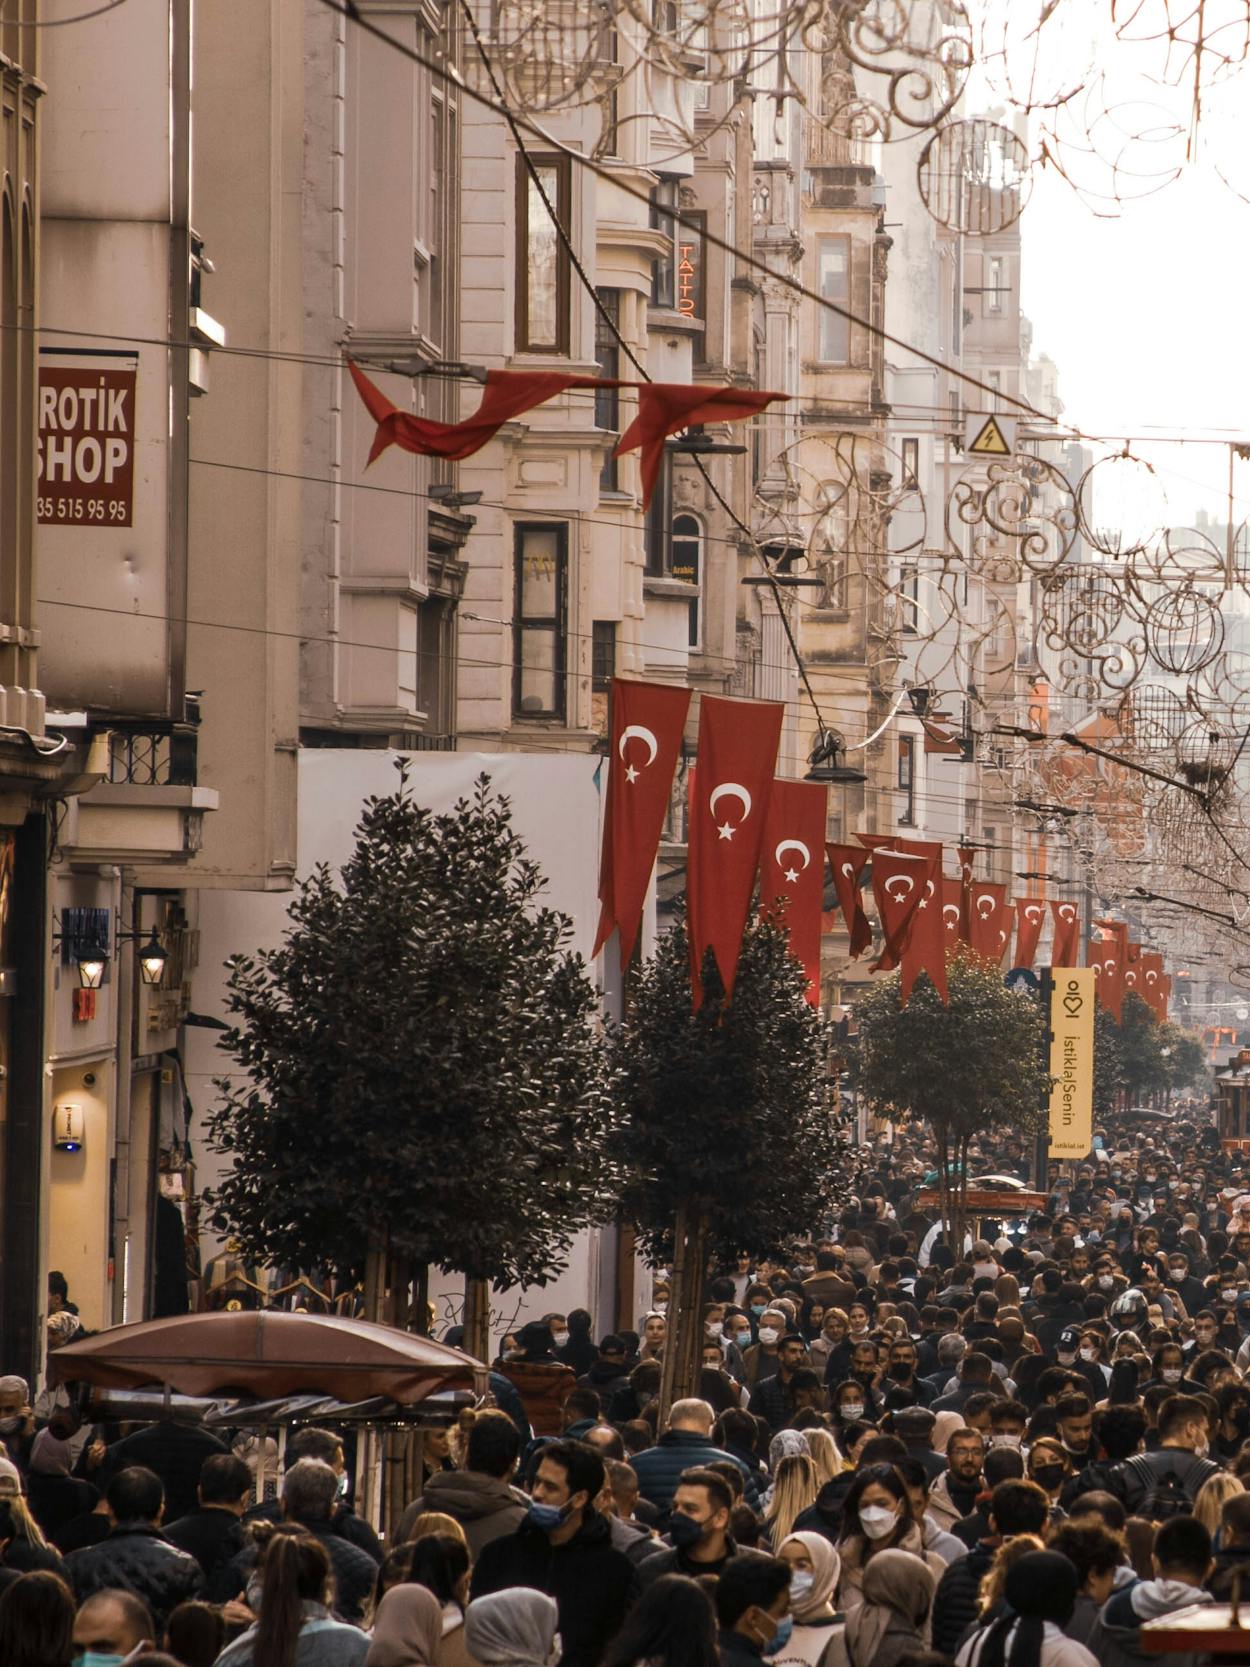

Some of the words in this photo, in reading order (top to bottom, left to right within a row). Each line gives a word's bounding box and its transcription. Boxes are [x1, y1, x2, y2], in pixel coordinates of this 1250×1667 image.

[57, 498, 83, 519] 515
[88, 499, 104, 520] 95
[109, 501, 126, 521] 95
